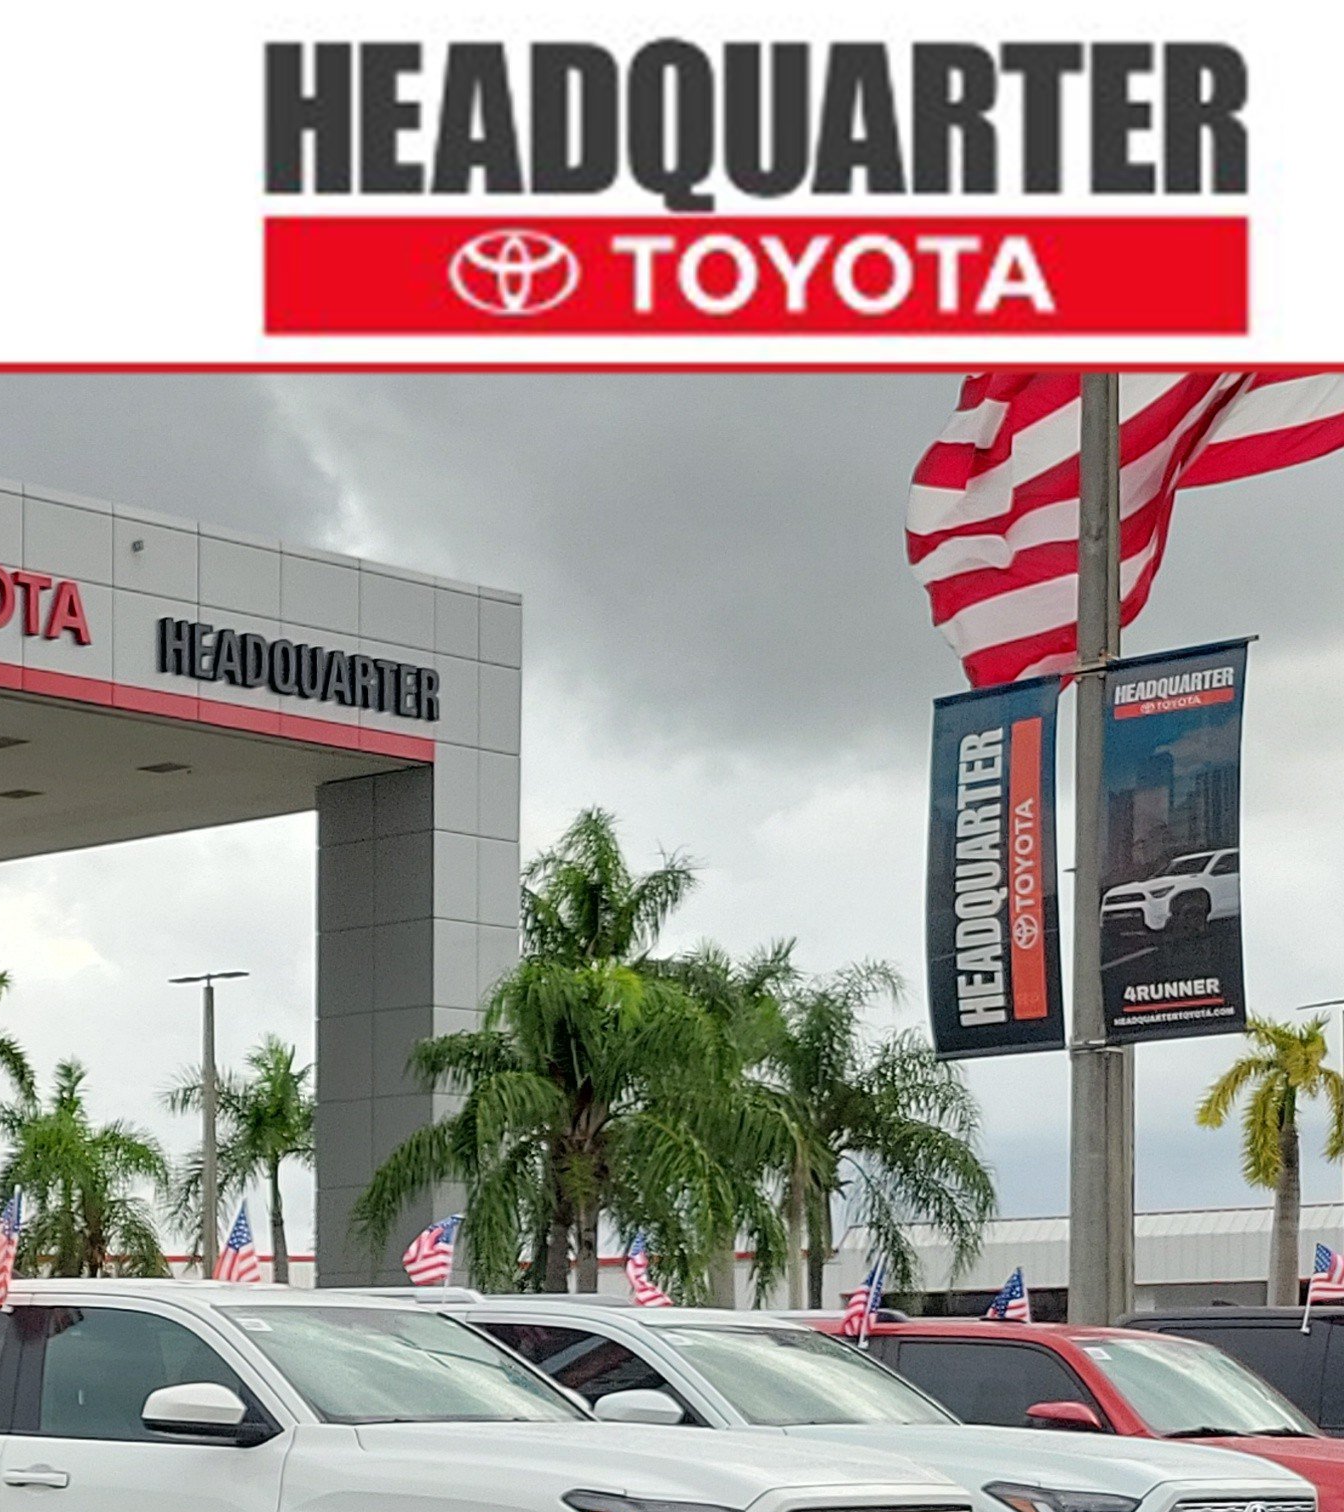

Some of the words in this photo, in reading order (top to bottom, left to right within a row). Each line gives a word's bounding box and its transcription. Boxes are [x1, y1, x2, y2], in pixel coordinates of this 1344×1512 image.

[157, 616, 441, 722] HEADQUARTER
[1114, 666, 1235, 706] HEADQUARTER
[1156, 693, 1202, 711] TOYOTA
[1014, 797, 1036, 914] TOYOTA
[955, 726, 1008, 1028] HEADQUARTER
[1123, 978, 1221, 1003] 4RUNNER
[1113, 1006, 1236, 1026] HEADQUARTERTOYOTA.COM
